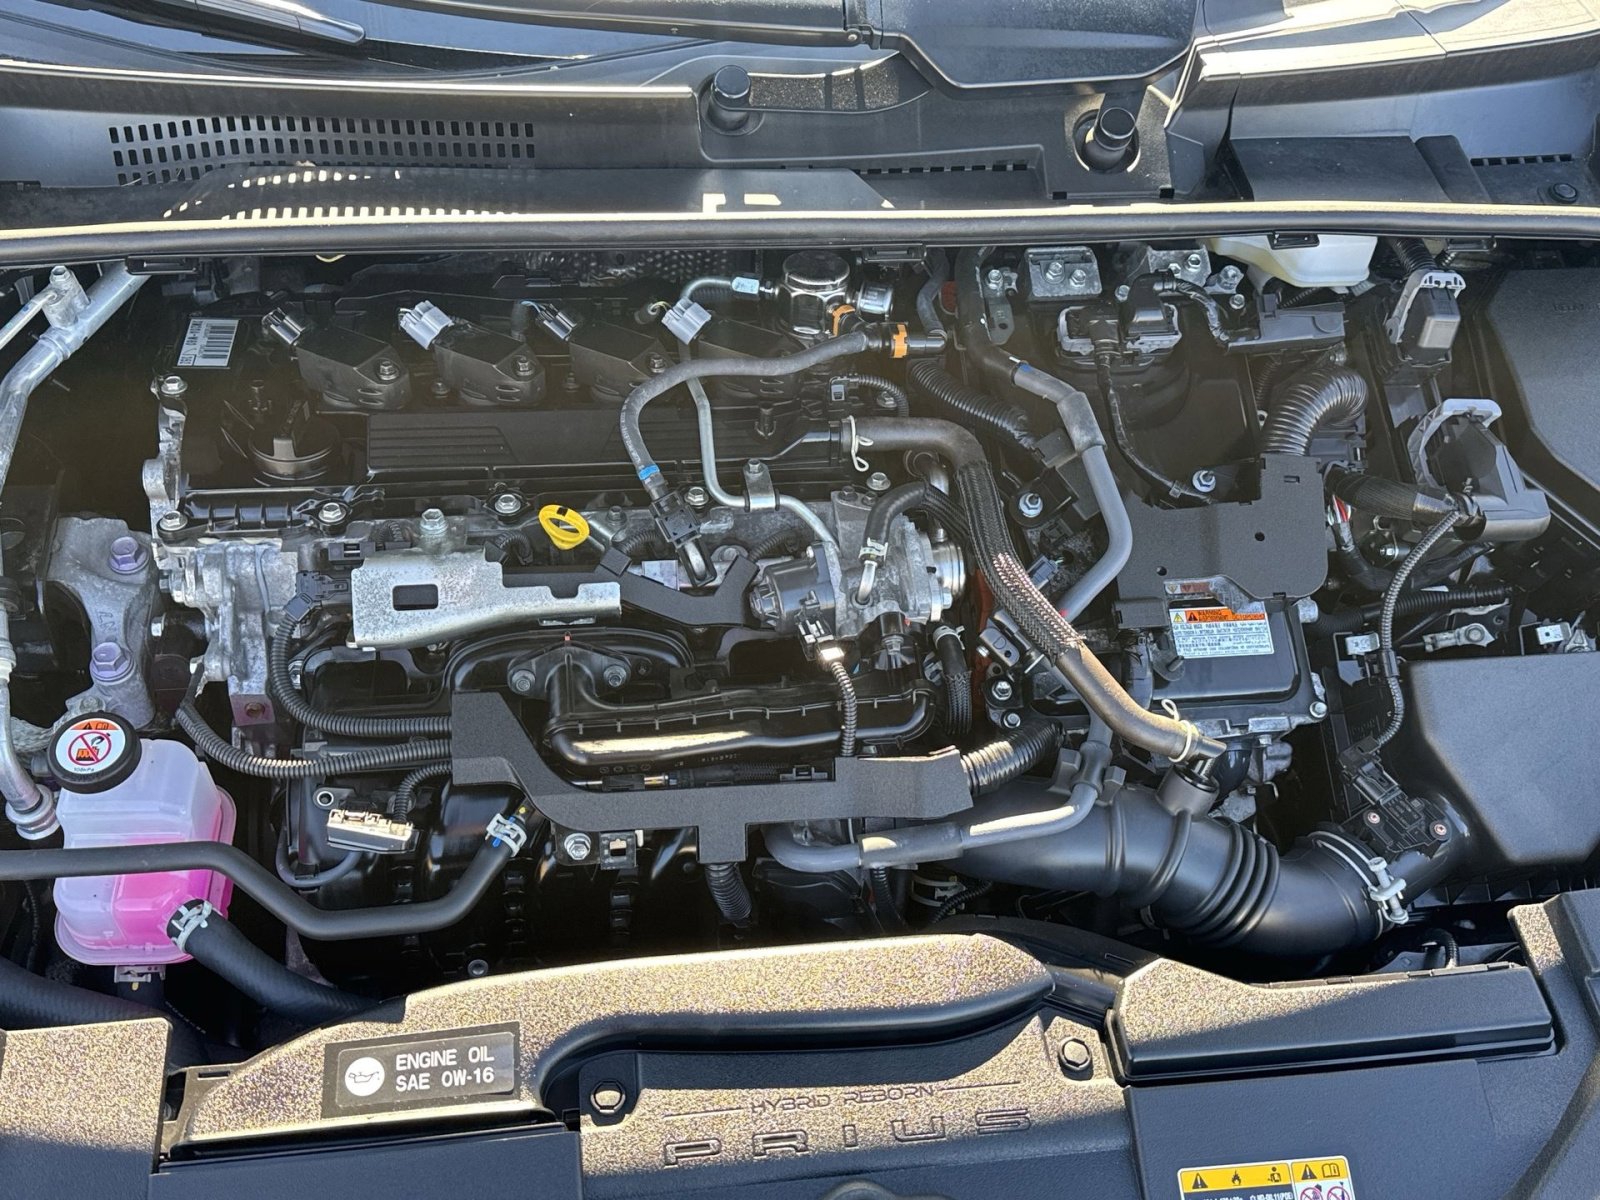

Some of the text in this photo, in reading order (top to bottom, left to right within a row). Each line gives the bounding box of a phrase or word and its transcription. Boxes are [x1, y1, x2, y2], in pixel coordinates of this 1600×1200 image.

[395, 1045, 495, 1071] ENGINE OIL
[395, 1066, 495, 1092] SAE 0W-16
[751, 1084, 935, 1114] HYBRID REBORN
[663, 1108, 1031, 1168] PRIUS
